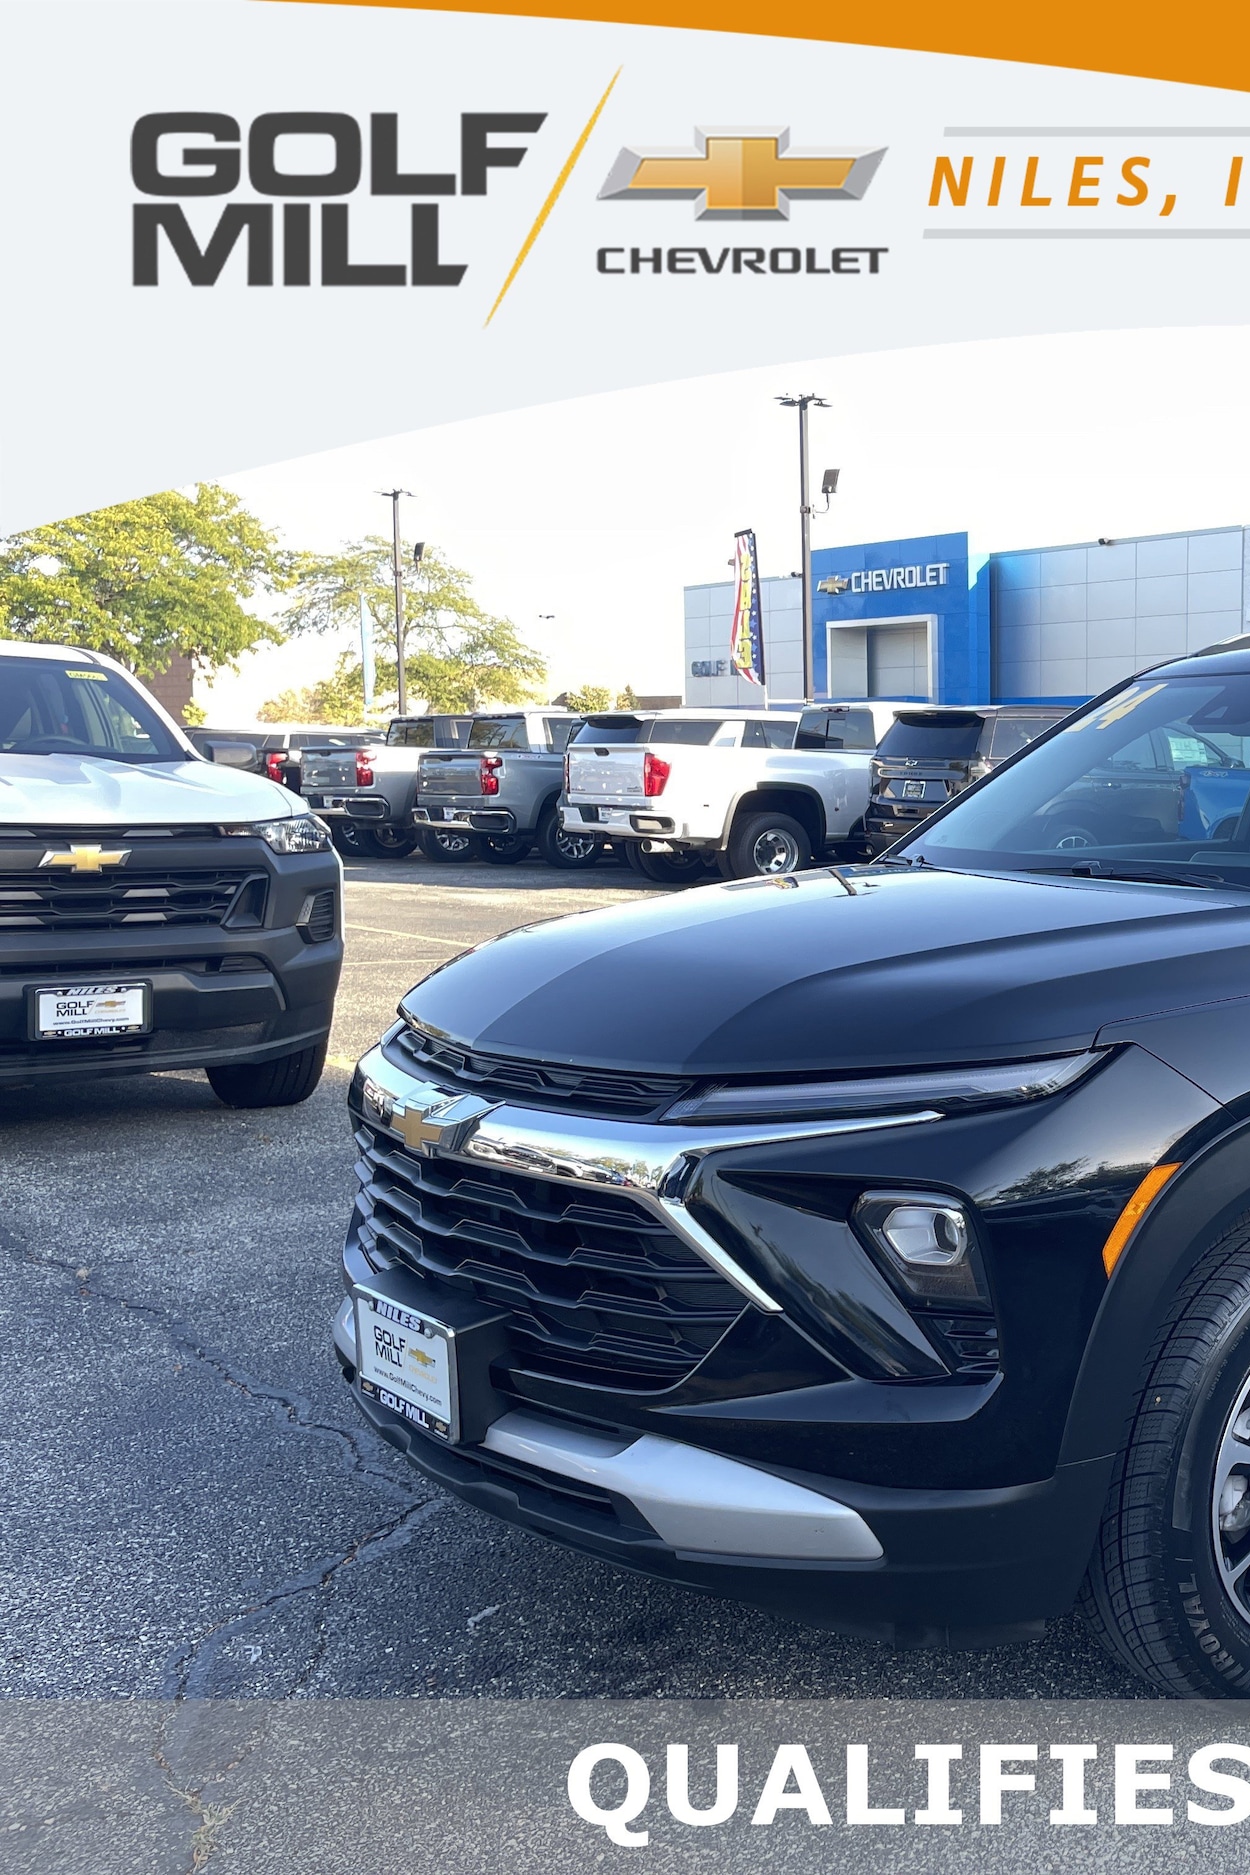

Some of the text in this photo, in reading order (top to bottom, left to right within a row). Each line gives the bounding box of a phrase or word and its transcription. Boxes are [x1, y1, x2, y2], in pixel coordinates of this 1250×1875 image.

[851, 563, 950, 593] CHEVROLET
[691, 660, 727, 677] GOLF
[66, 986, 118, 996] NILES
[56, 1000, 95, 1010] GOLF
[56, 1009, 87, 1017] MILL
[63, 1026, 120, 1037] GOLF MILL
[376, 1301, 421, 1332] NILES
[373, 1325, 406, 1352] GOLF
[374, 1341, 403, 1367] MILL
[373, 1366, 442, 1406] www.GolfMillChevy.com
[380, 1389, 406, 1413] GOLF
[405, 1404, 430, 1429] MILL
